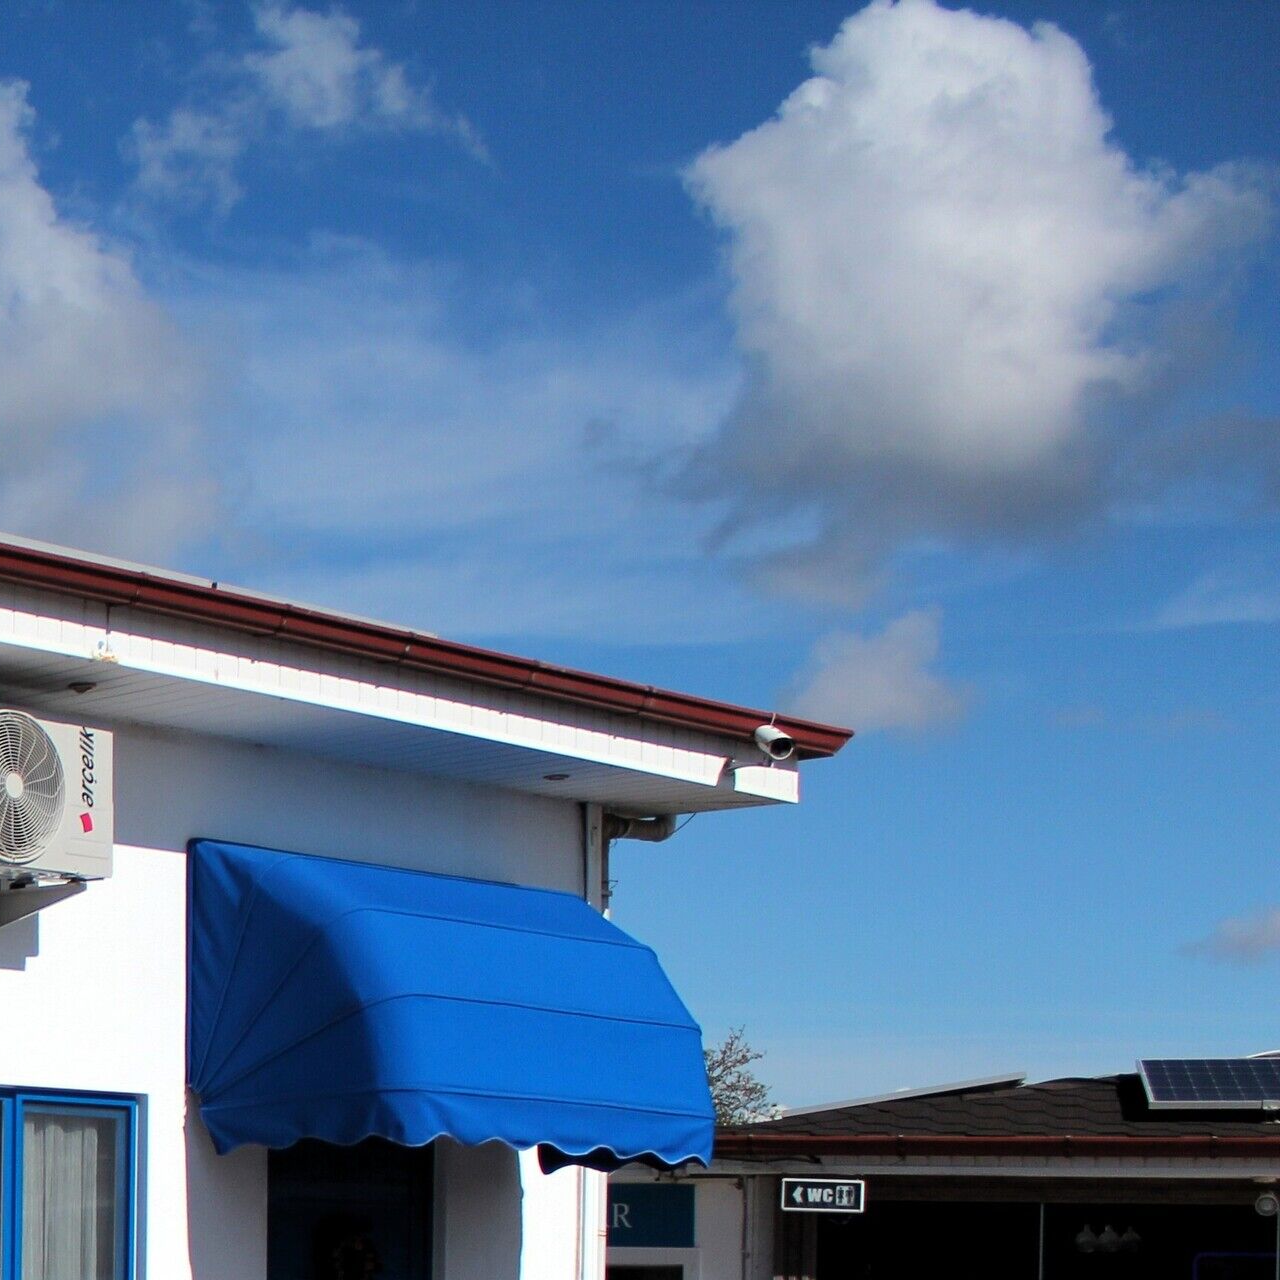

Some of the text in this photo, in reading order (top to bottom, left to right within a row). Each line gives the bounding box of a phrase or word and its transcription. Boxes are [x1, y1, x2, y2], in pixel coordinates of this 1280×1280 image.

[80, 726, 97, 808] arçelik
[807, 1188, 834, 1203] WC
[607, 1203, 633, 1229] R
